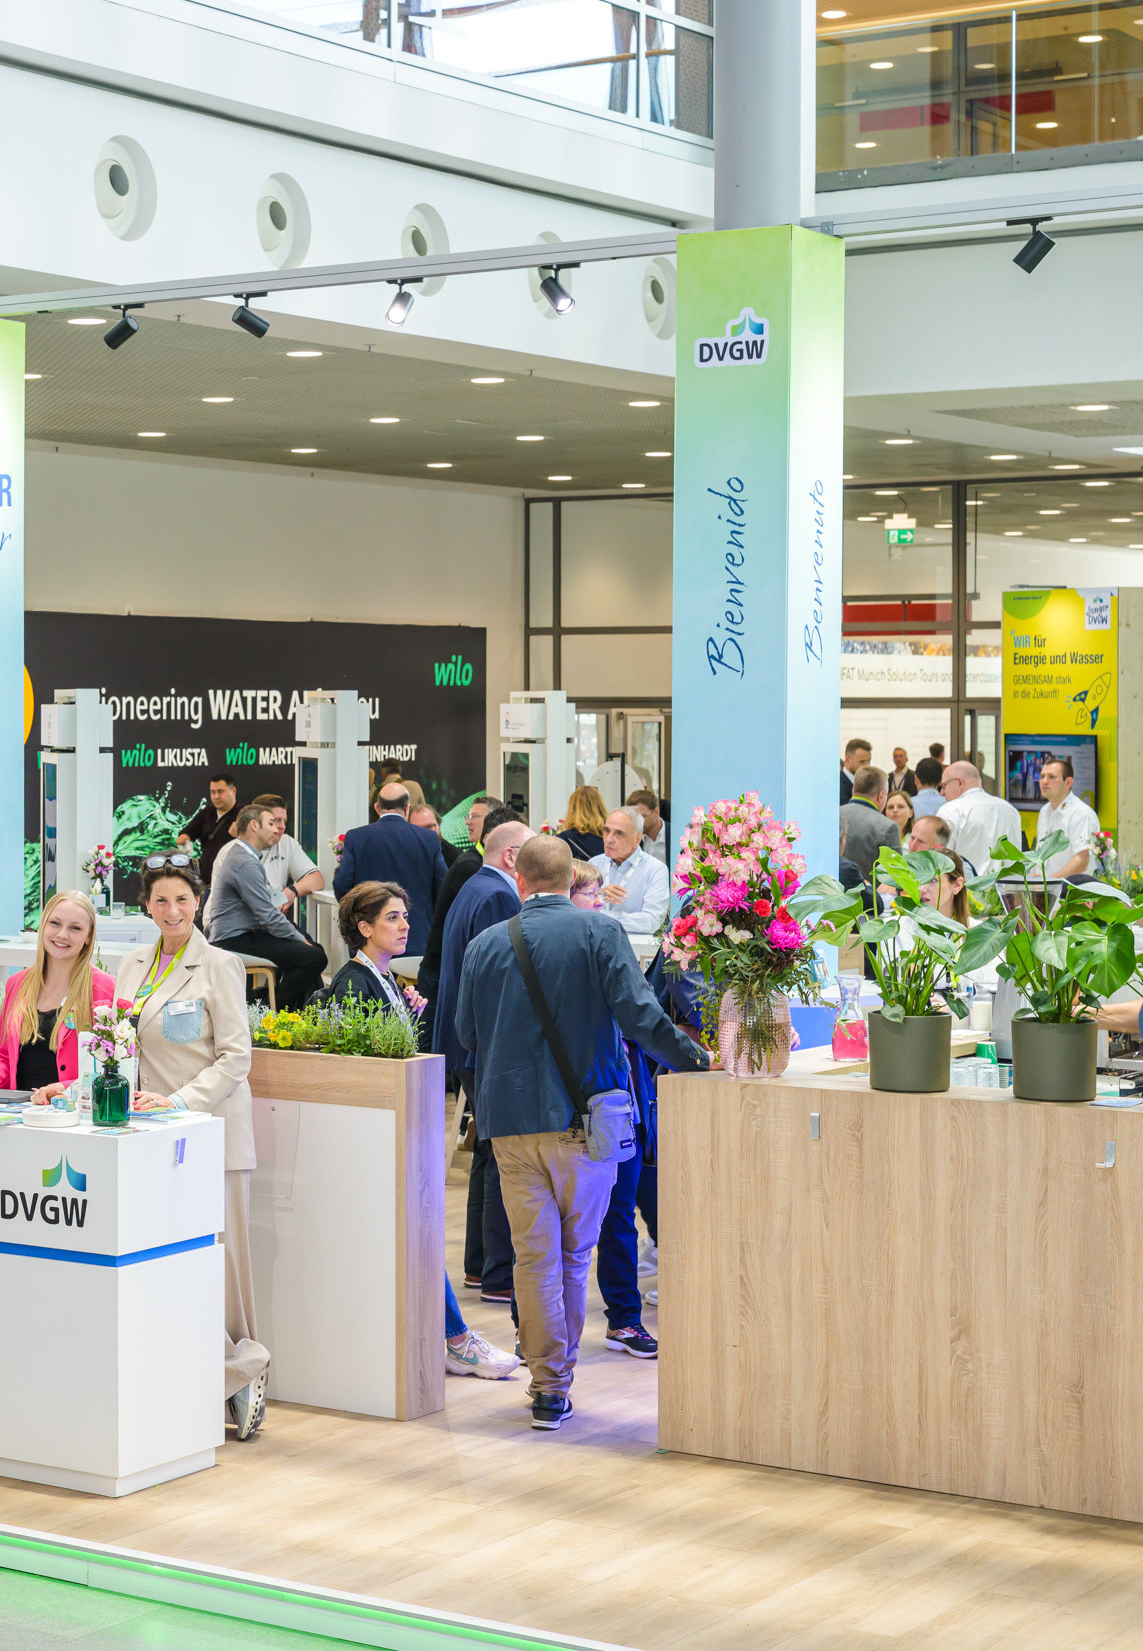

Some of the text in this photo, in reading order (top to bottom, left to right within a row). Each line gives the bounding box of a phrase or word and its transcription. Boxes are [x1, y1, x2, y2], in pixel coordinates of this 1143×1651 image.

[699, 339, 765, 363] DVGW
[706, 475, 749, 680] Bienvenido
[804, 477, 827, 669] Benvenuto
[1013, 634, 1046, 648] WIR für
[434, 655, 473, 687] wilo
[1013, 651, 1105, 668] Energie und Wasser
[857, 667, 886, 682] Munich
[1013, 674, 1072, 685] GEMEINSAM stark
[100, 687, 203, 729] ioneering
[208, 690, 283, 720] WATER
[121, 743, 209, 767] wilo LIKUSTA
[225, 742, 296, 766] wilo MARTI
[357, 744, 418, 762] INHARDT
[0, 1189, 89, 1228] DVGW
